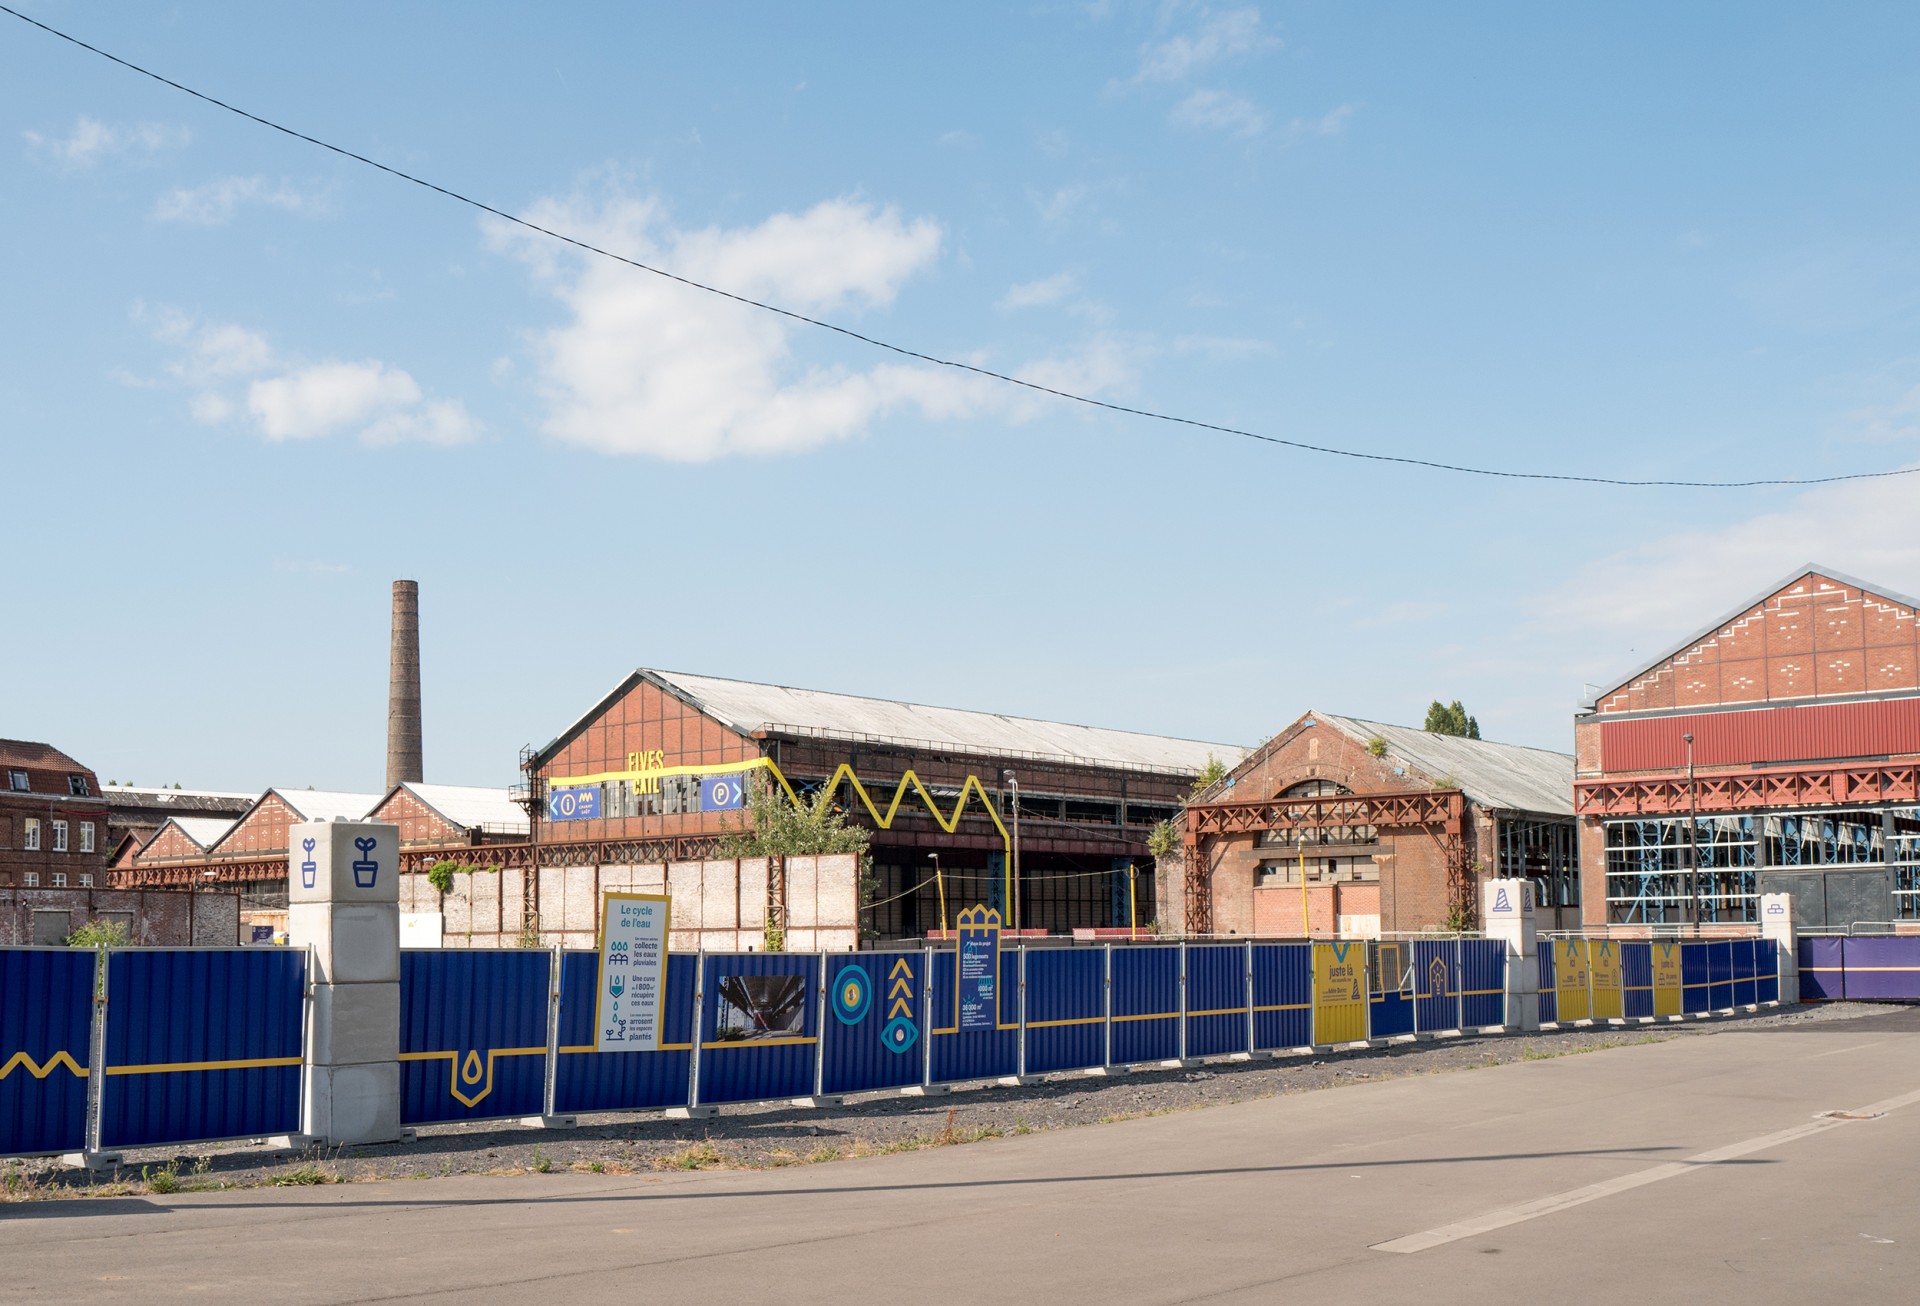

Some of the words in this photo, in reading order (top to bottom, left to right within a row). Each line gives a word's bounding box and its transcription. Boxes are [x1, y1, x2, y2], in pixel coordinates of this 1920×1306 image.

[628, 750, 664, 771] FIVES
[717, 788, 725, 800] P
[621, 904, 631, 915] Le
[632, 906, 653, 917] cycle
[621, 918, 631, 928] de
[632, 918, 651, 928] l'eau
[634, 941, 658, 950] collecte
[633, 950, 643, 958] les
[633, 959, 657, 967] pluviales
[1329, 964, 1346, 980] juste
[1347, 963, 1353, 976] là
[631, 991, 655, 999] récupère
[629, 1032, 652, 1042] plantés
